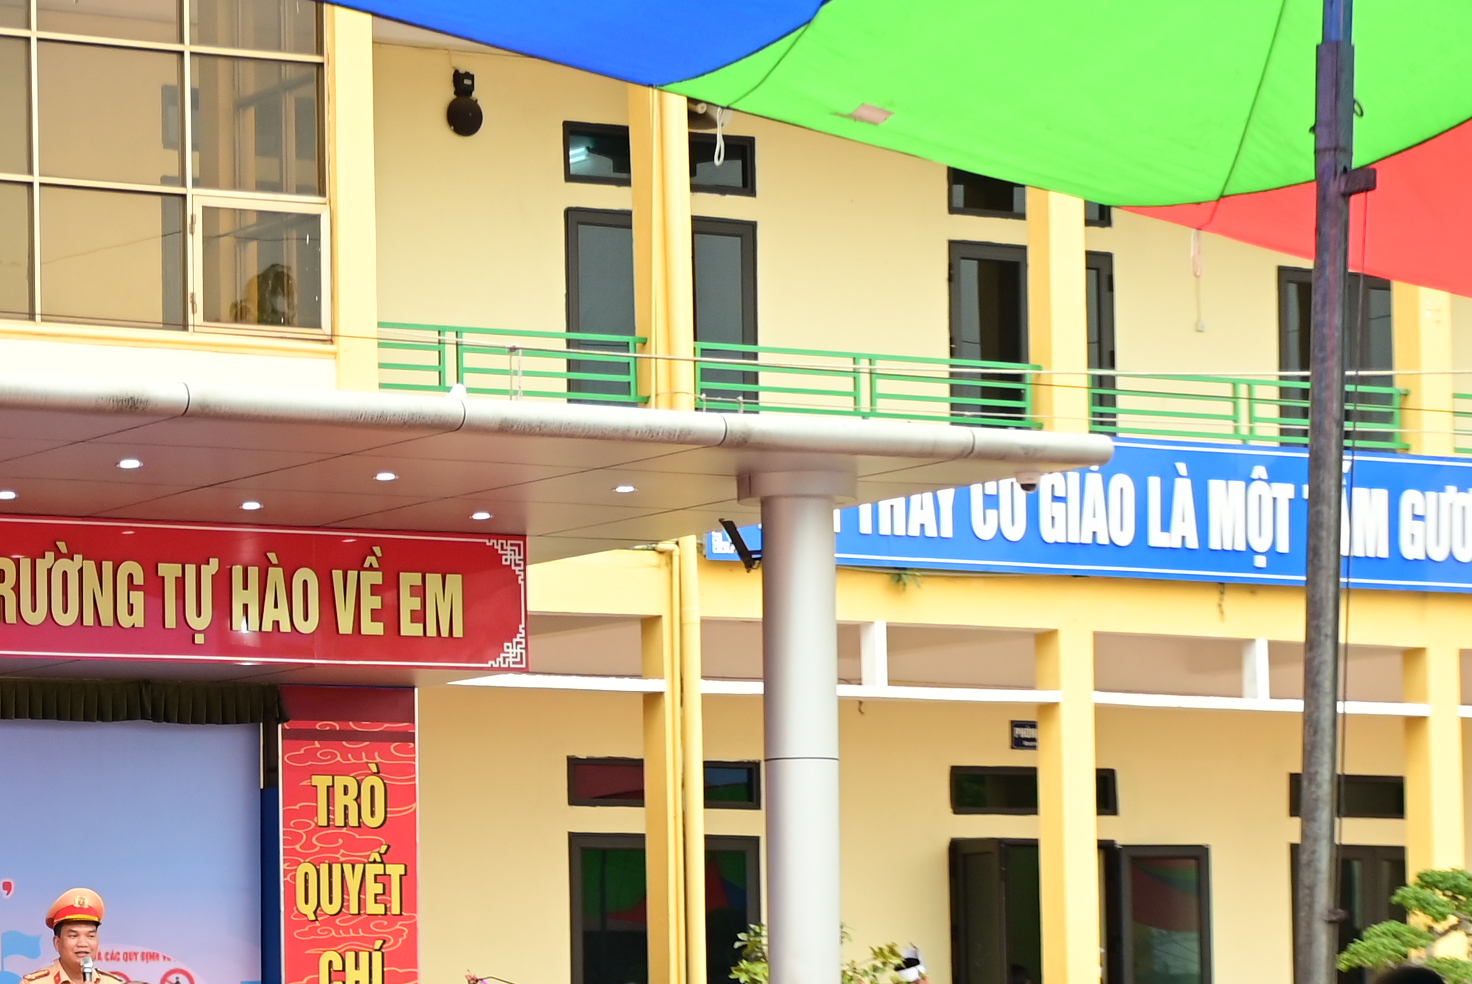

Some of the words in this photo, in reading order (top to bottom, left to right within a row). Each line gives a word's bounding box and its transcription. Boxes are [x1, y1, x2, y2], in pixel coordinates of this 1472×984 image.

[1039, 464, 1136, 547] GIÁO
[1147, 462, 1200, 549] LÀ
[1208, 466, 1296, 568] MỘT
[156, 556, 219, 645] TỰ
[230, 551, 320, 635] HÀO
[331, 545, 384, 637] VỀ
[399, 571, 464, 639] EM
[310, 763, 389, 829] TRÒ
[295, 843, 407, 922] QUYẾT
